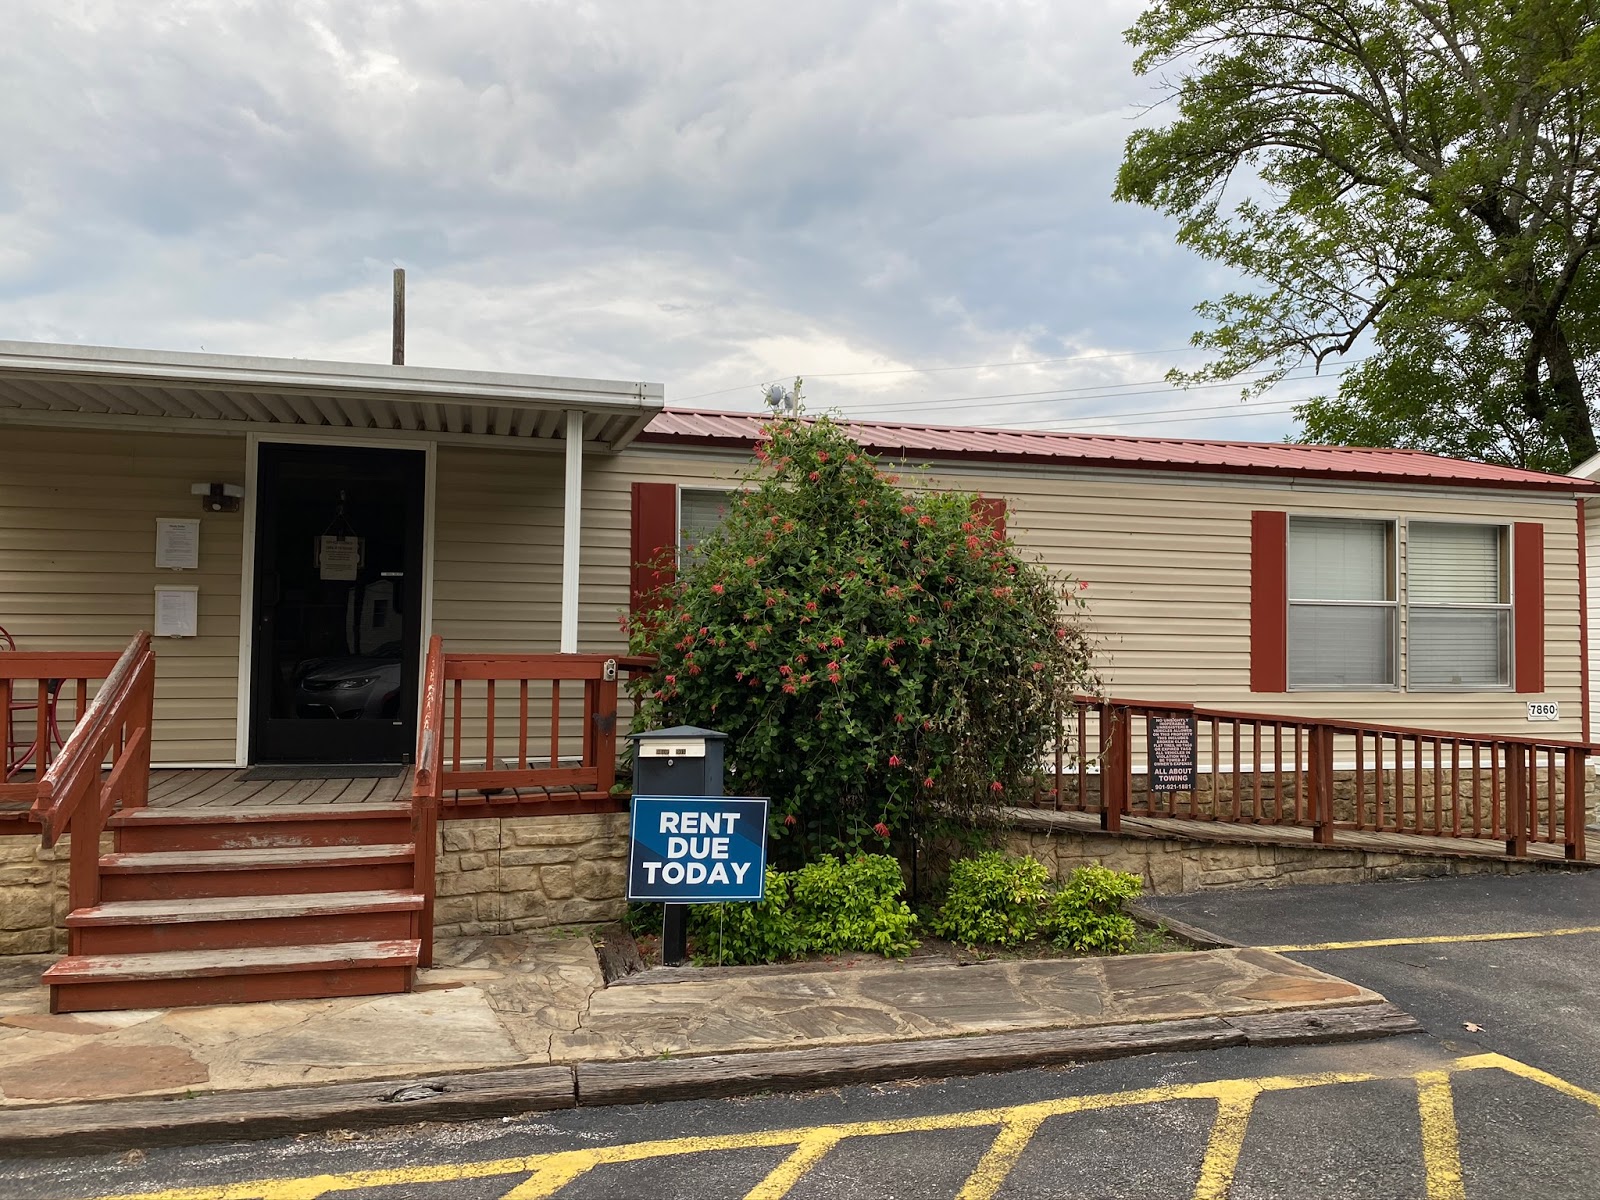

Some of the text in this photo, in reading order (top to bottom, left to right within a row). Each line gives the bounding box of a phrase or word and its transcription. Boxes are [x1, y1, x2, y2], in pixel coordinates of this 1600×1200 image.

[1530, 705, 1555, 714] 7860
[659, 812, 741, 834] RENT
[667, 837, 730, 859] DUE
[643, 862, 751, 885] TODAY
